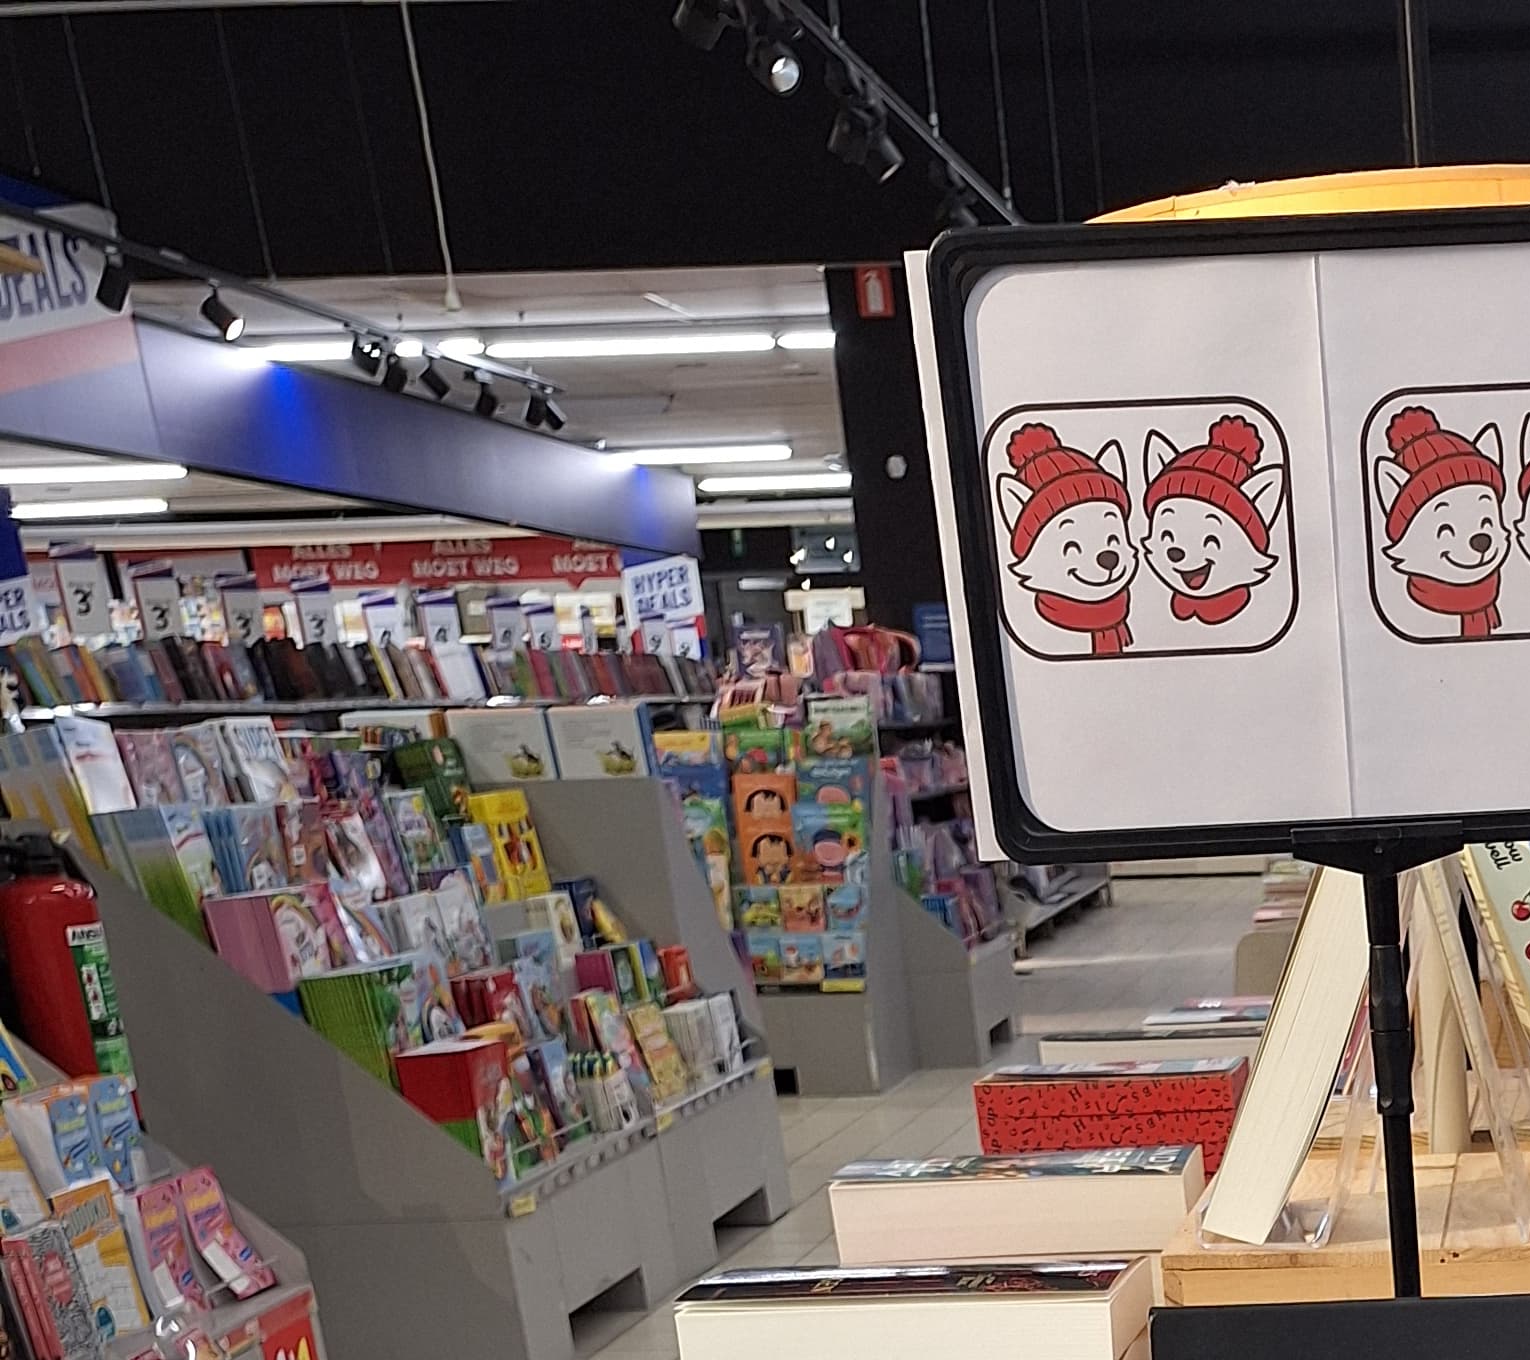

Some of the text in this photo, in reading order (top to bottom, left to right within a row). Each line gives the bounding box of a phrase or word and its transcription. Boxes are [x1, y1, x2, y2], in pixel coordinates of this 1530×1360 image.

[412, 557, 519, 578] MOET WEG
[632, 563, 689, 594] HYPER
